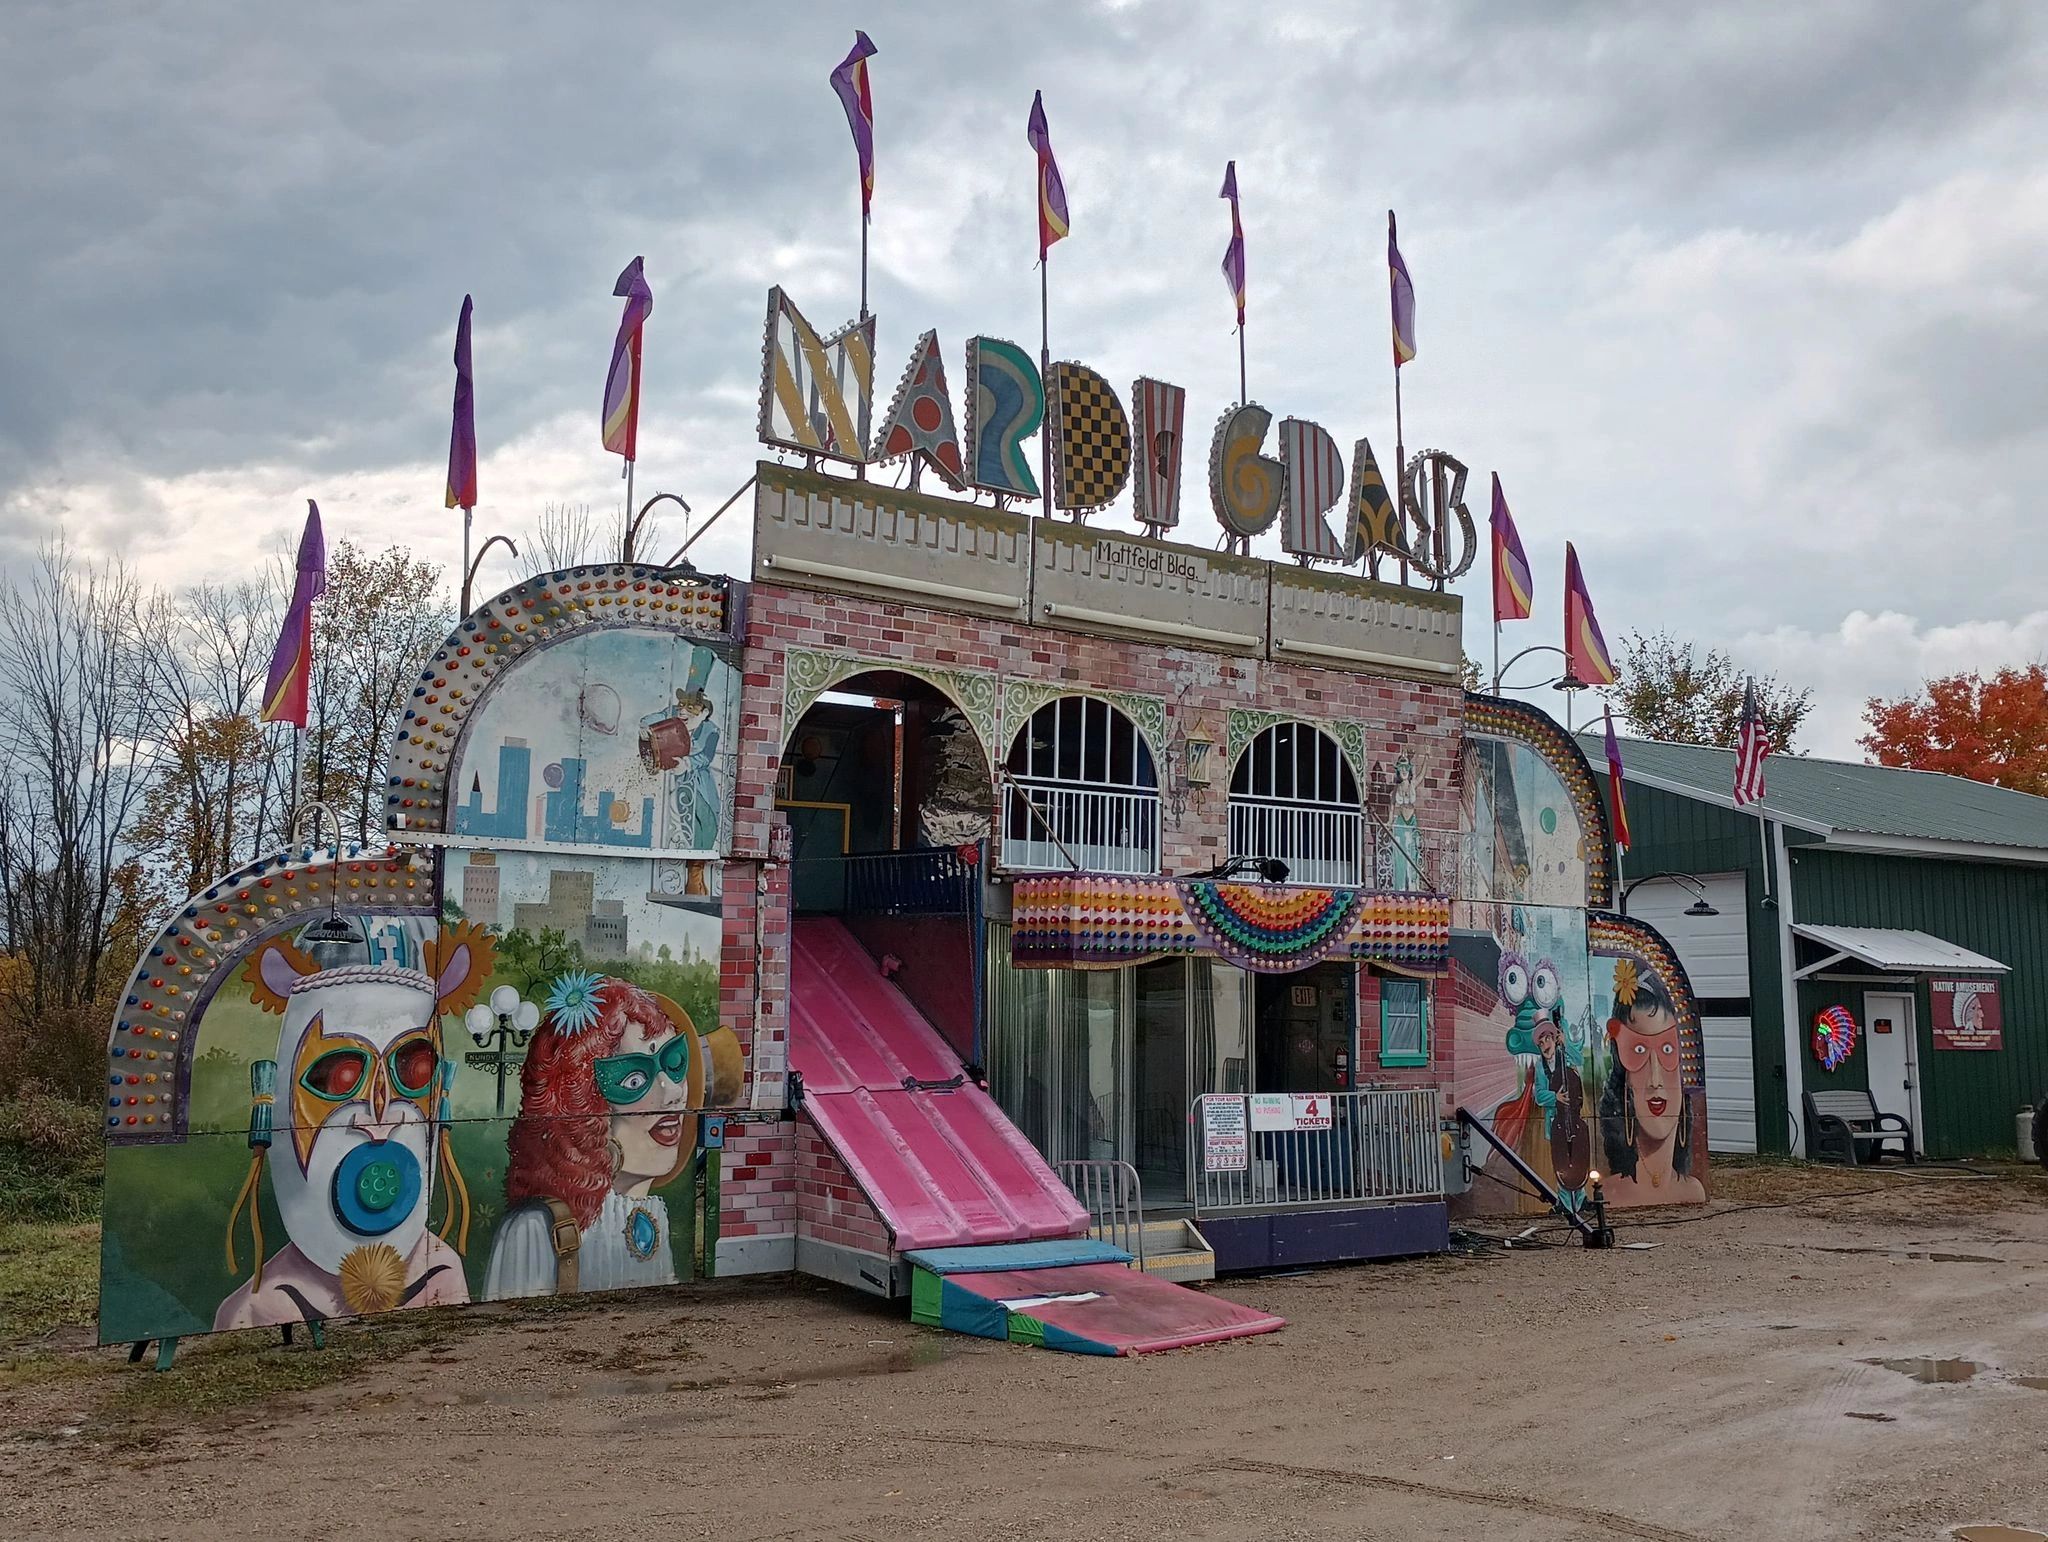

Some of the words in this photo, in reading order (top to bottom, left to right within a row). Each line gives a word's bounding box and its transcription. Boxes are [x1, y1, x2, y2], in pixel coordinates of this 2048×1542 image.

[758, 285, 1186, 527] MARDI
[1208, 399, 1478, 583] GRAS
[1098, 541, 1164, 571] Mattfeldt
[1167, 554, 1199, 580] Bldg.
[1932, 981, 1954, 992] NATIVE
[1295, 987, 1312, 1004] EXIT
[1306, 1100, 1319, 1117] 4
[1295, 1117, 1330, 1126] TICKETS
